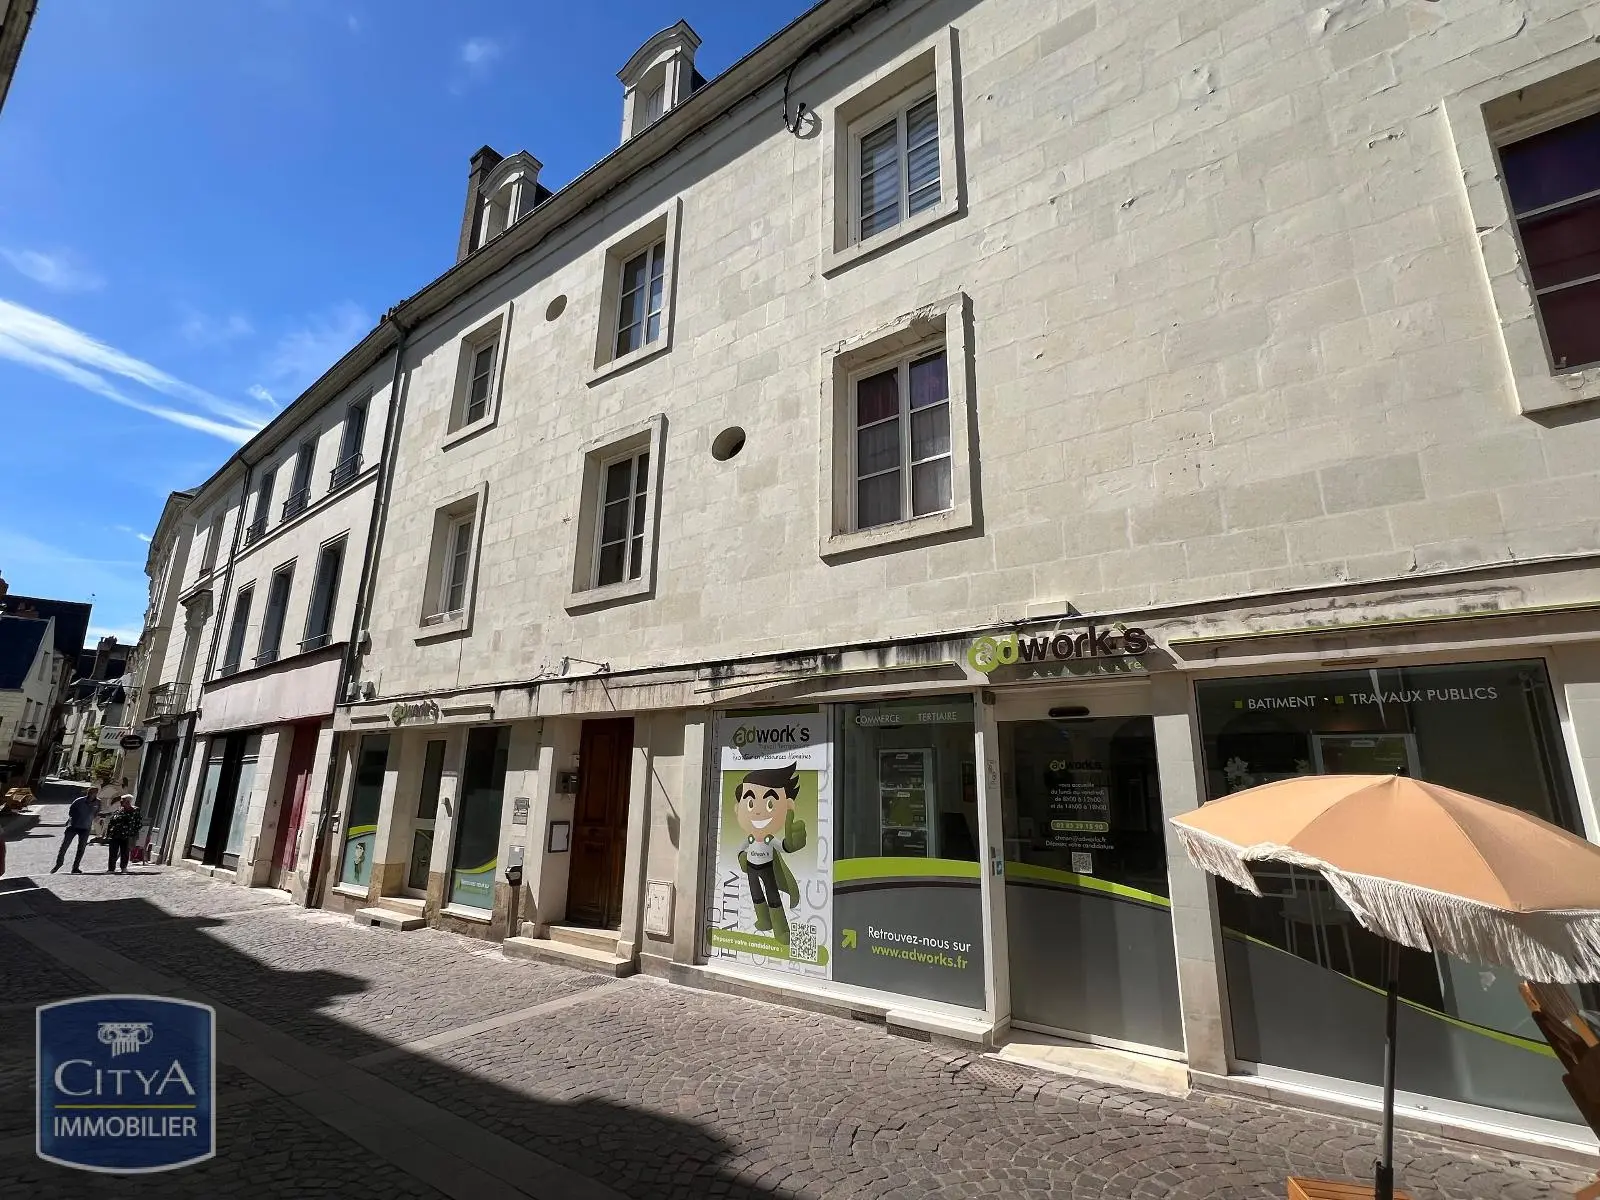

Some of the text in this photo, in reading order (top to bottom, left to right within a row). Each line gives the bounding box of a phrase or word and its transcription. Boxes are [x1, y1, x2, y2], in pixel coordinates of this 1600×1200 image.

[1248, 695, 1316, 710] BATIMENT
[1349, 687, 1499, 705] TRAVAUX PUBLICS
[855, 714, 900, 725] COMMERCE
[918, 711, 957, 722] TERTIAIRE
[868, 926, 972, 953] Retrouvez-nous sur
[871, 945, 968, 969] www.adworks.fr
